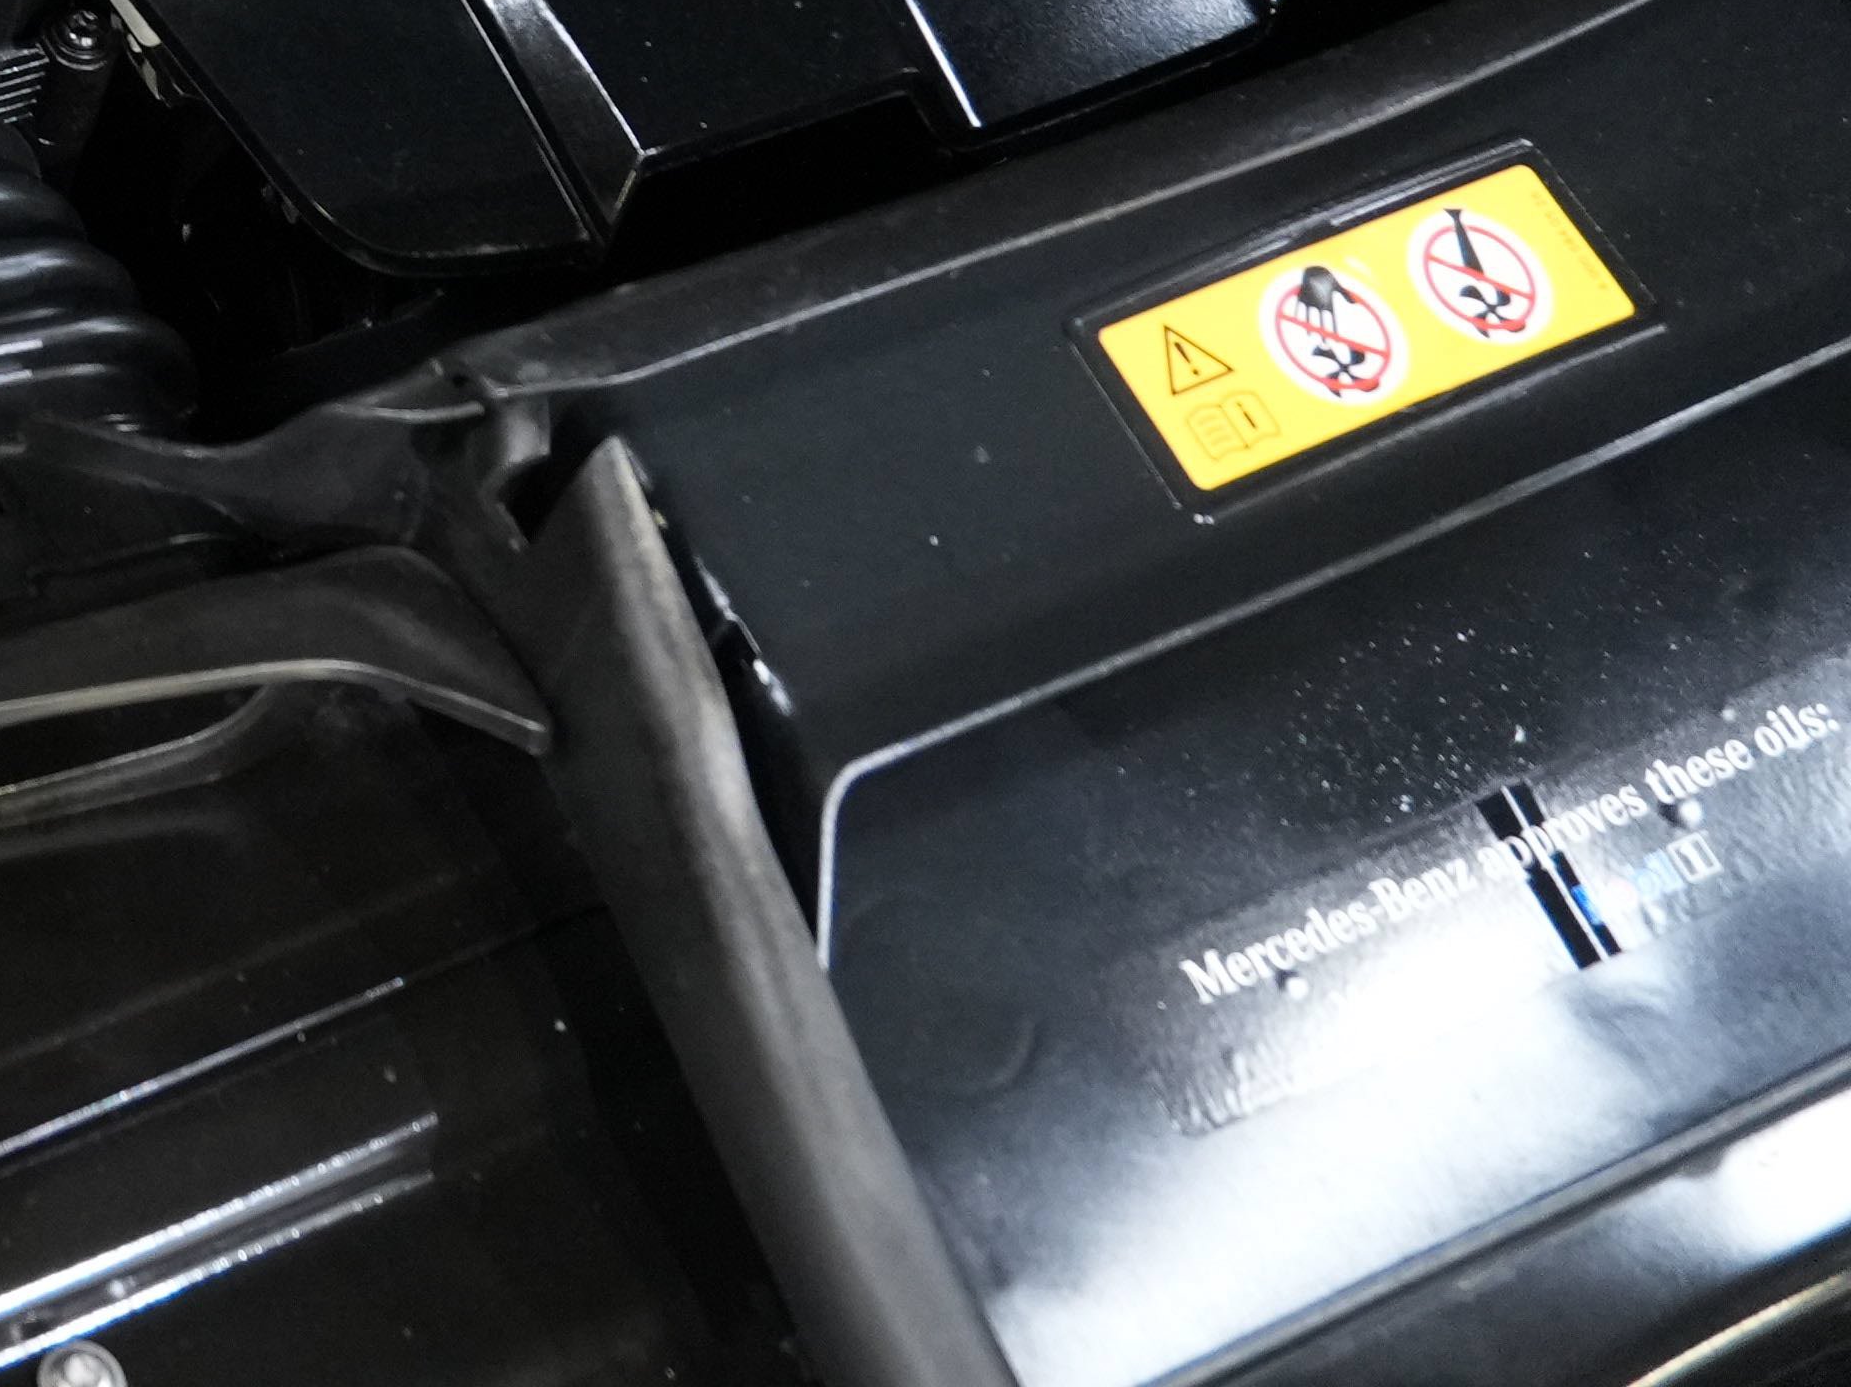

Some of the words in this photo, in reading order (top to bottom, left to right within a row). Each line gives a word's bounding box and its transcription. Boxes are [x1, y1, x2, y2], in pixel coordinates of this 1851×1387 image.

[1179, 854, 1479, 1005] Mercedes-Benz
[1482, 779, 1651, 883] approves
[1643, 738, 1758, 805] these
[1756, 700, 1843, 758] oils:
